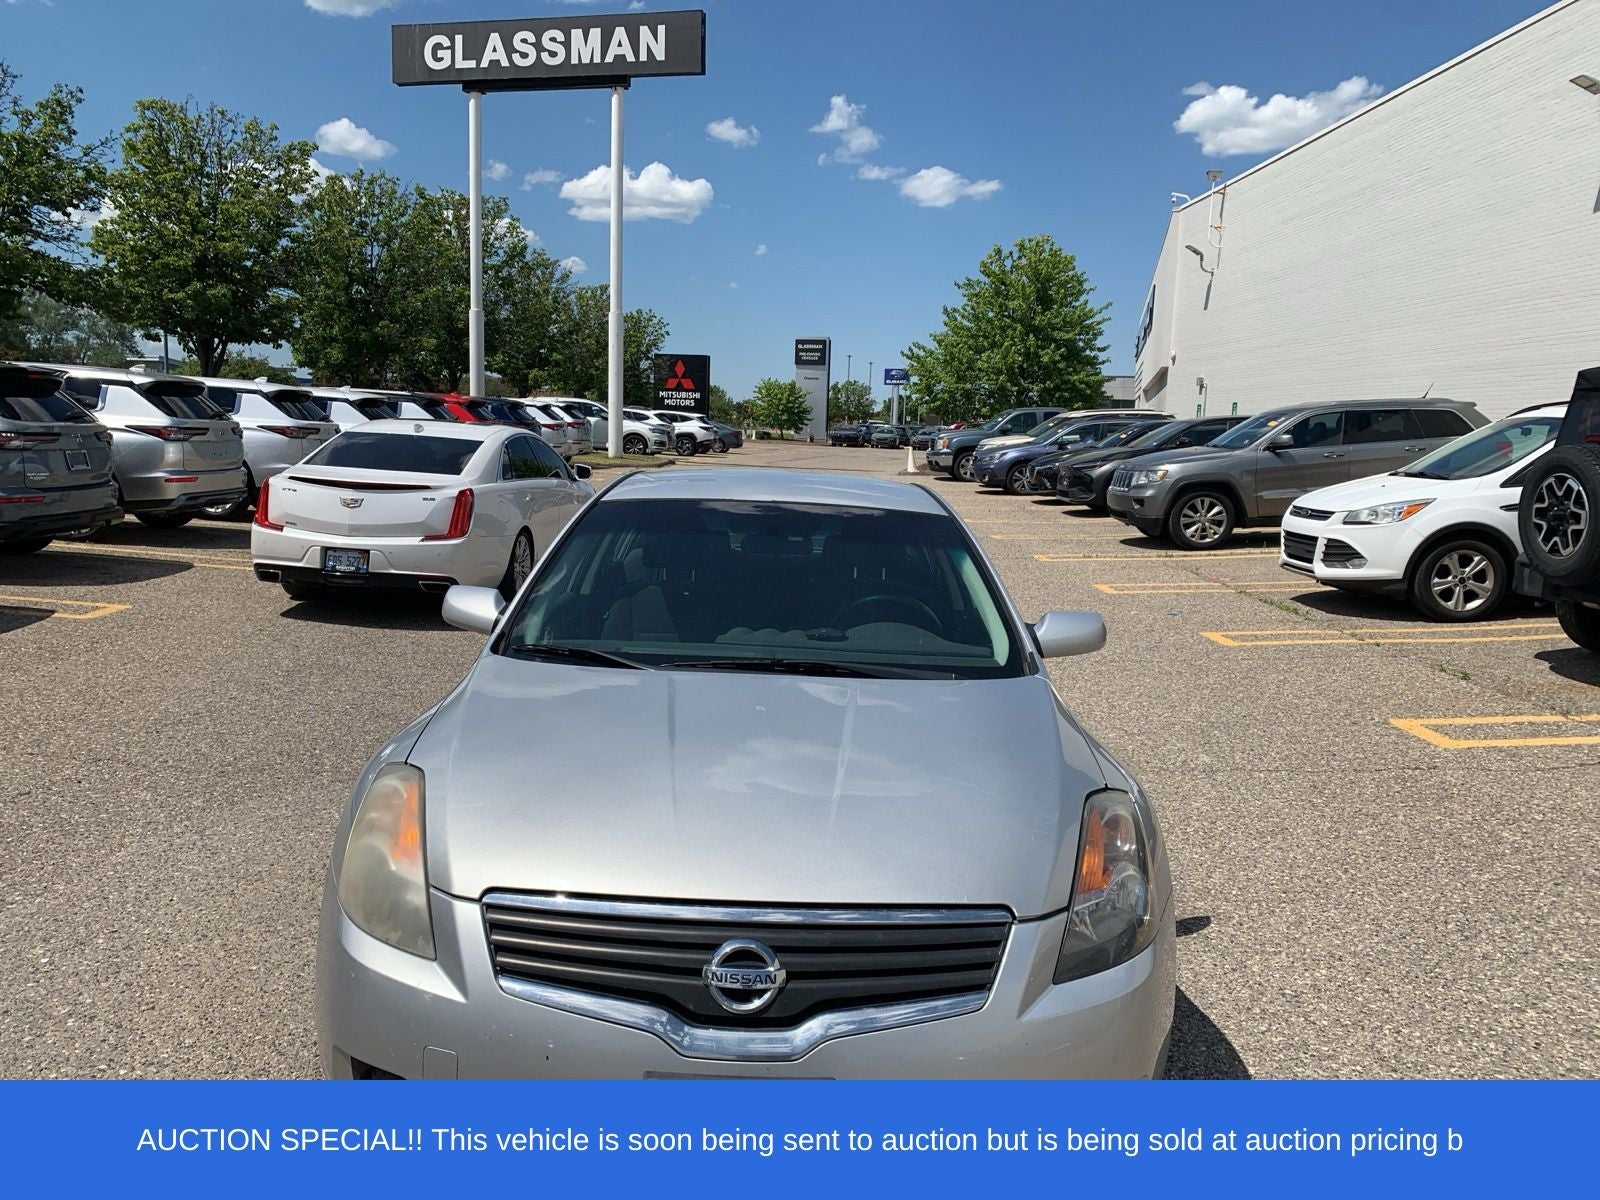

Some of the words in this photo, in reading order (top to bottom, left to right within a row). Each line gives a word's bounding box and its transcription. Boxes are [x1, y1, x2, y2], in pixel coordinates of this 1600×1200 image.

[423, 24, 667, 71] GLASSMAN
[659, 390, 701, 399] MITSUBISHI
[664, 399, 695, 407] MOTORS
[711, 971, 777, 986] NISSAN
